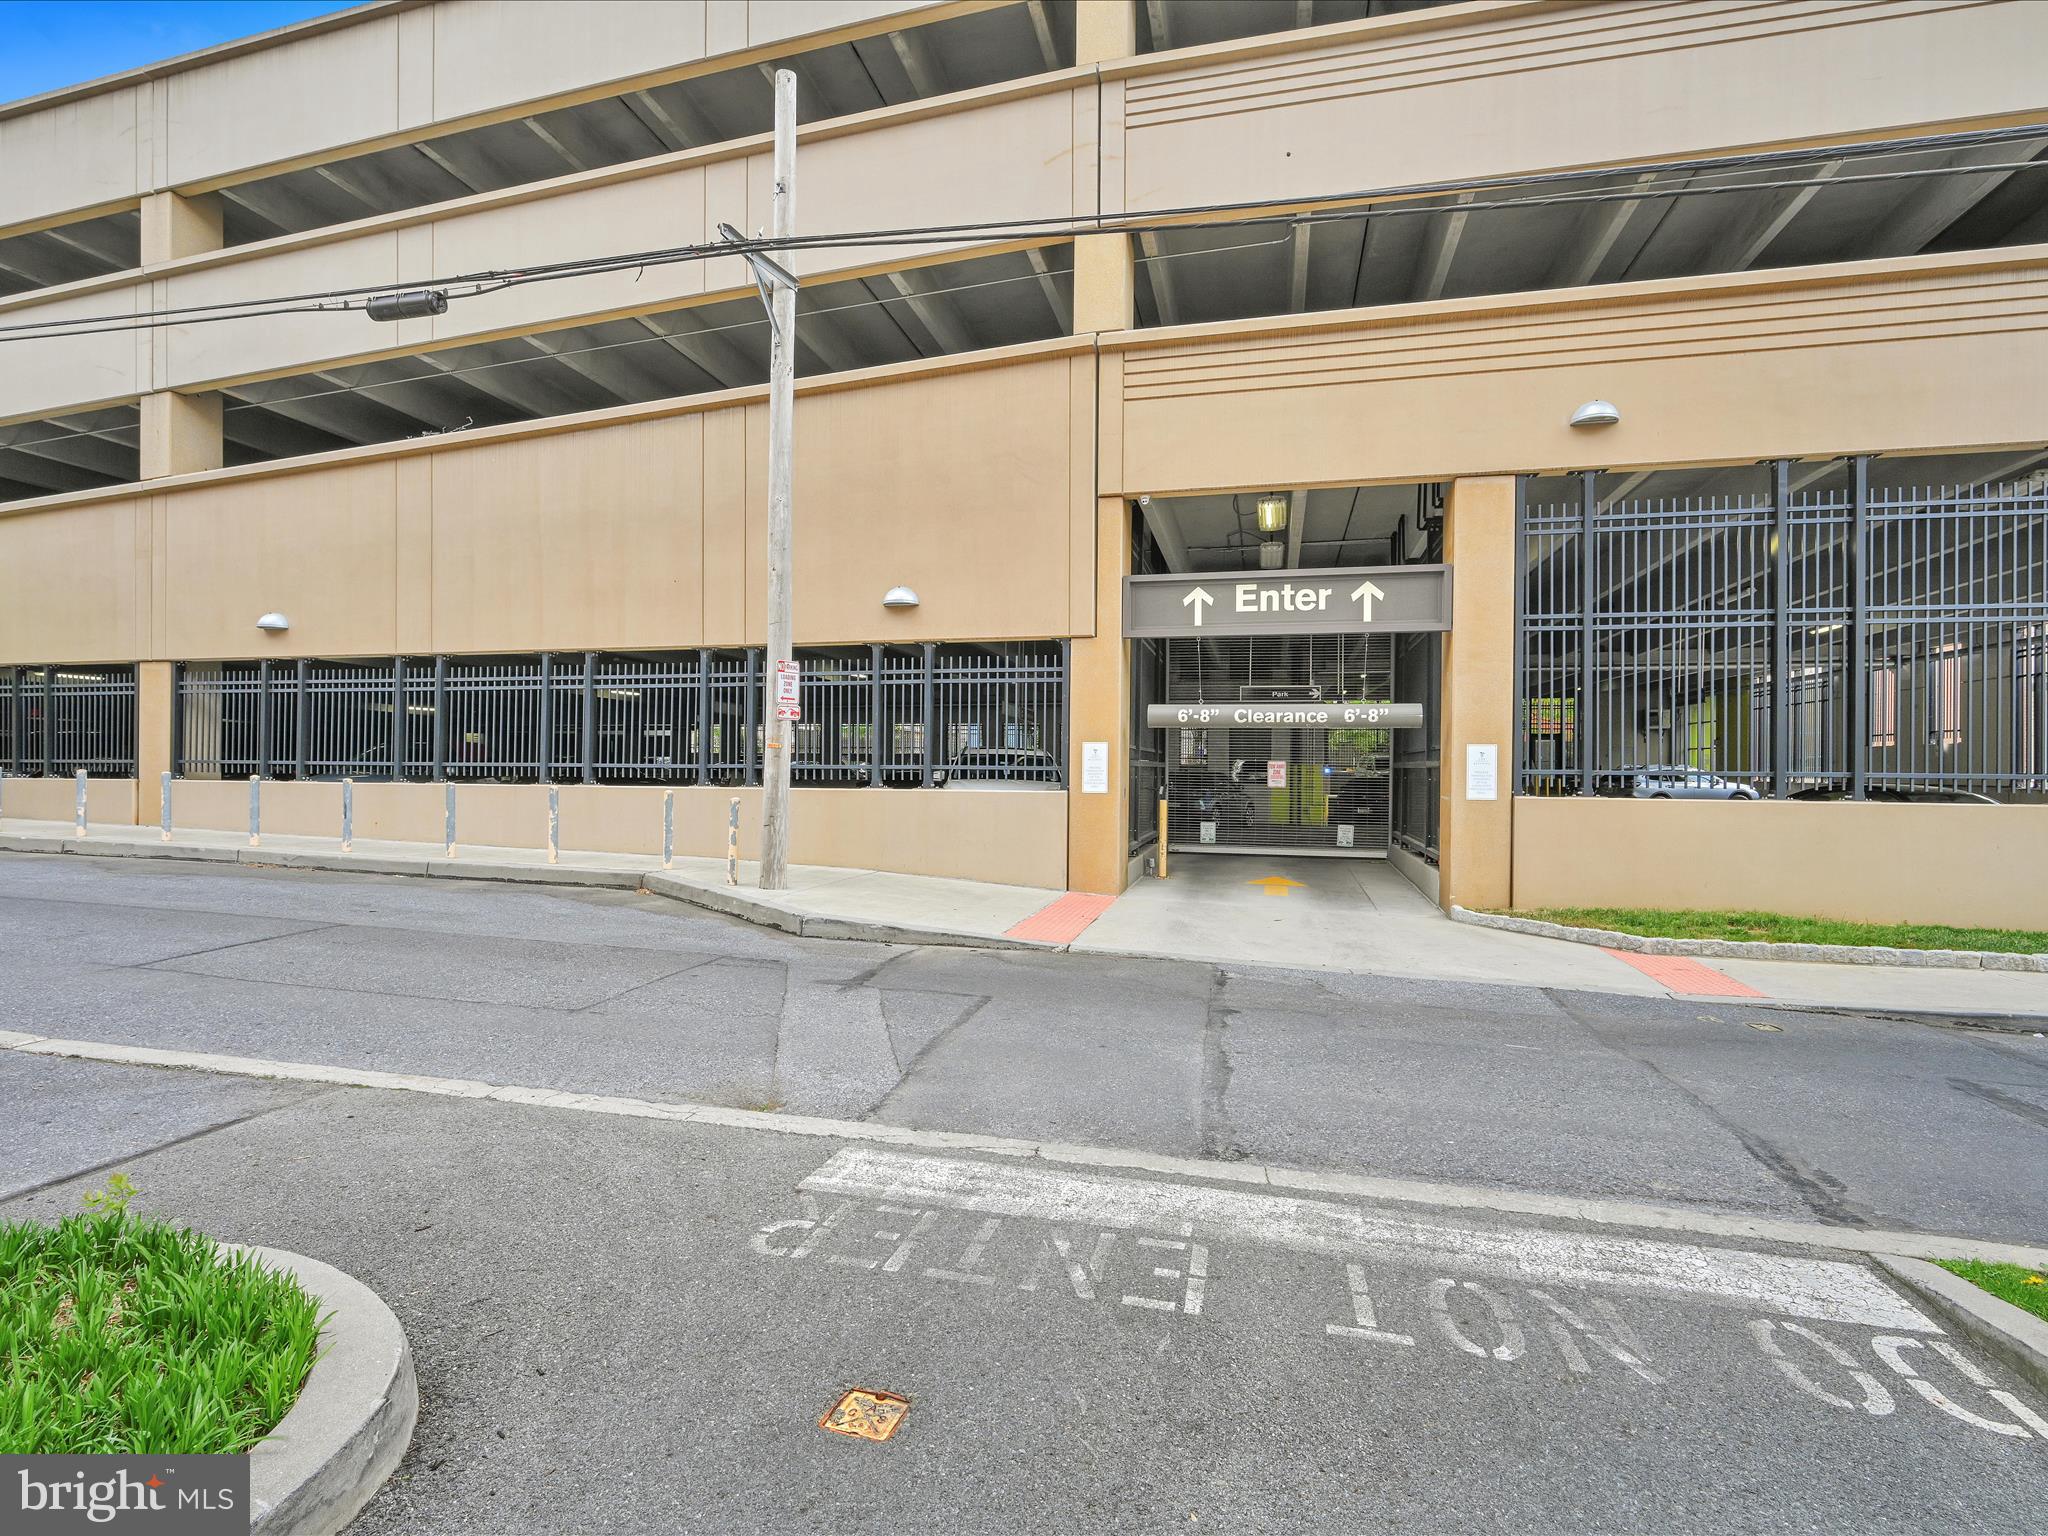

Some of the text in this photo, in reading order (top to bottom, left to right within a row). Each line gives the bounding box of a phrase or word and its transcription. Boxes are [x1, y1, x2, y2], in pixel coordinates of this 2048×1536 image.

[1235, 583, 1332, 612] Enter
[780, 673, 796, 681] LOADING
[1233, 708, 1329, 723] Clearance
[750, 1195, 2048, 1441] DO NOT ENTER
